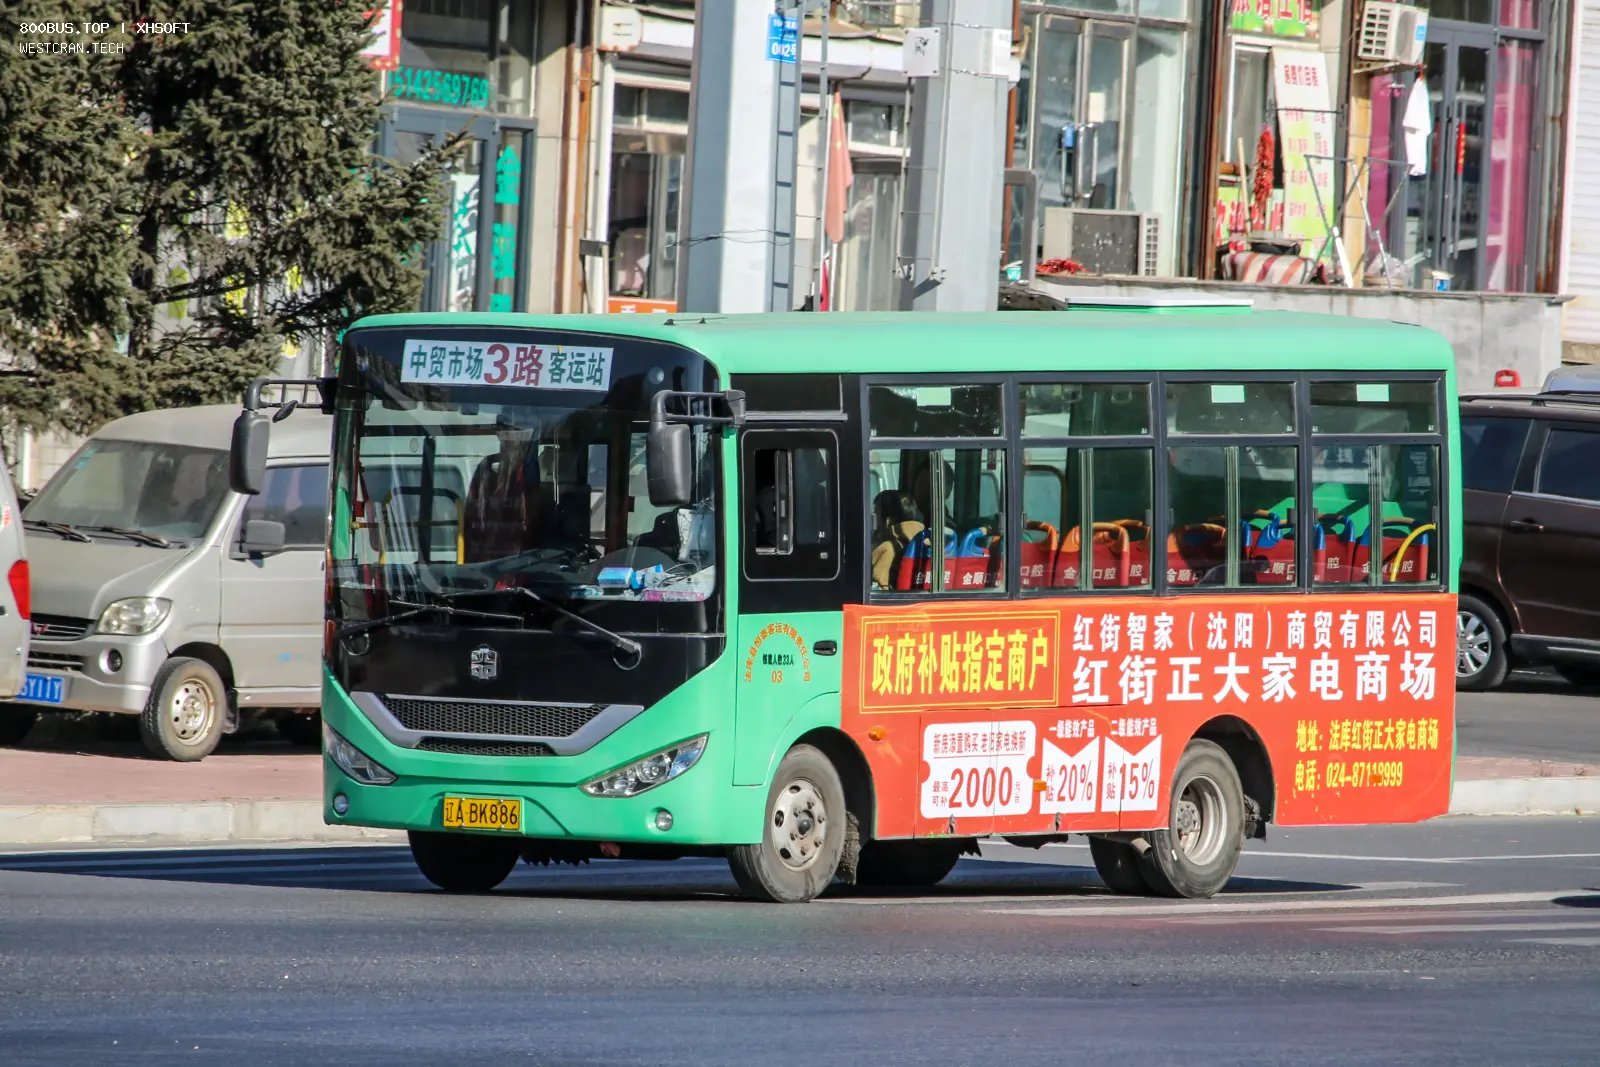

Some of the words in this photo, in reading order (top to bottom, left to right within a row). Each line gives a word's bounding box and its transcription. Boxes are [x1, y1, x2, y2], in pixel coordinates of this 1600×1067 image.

[410, 345, 484, 380] 中贸市场
[483, 343, 544, 387] 3路
[548, 350, 606, 386] 客运站
[1072, 609, 1437, 652] 红街智家（沈阳）商贸有限公司
[771, 670, 783, 683] 03
[872, 628, 1048, 696] 政府补贴指定商户
[1072, 651, 1436, 705] 红街正大家电商场
[1048, 719, 1095, 738] 一级能效产品
[1110, 718, 1157, 737] 二级能效产品
[948, 766, 1013, 808] 2000
[1044, 764, 1055, 802] 补贴
[1056, 760, 1093, 802] 20%
[1106, 762, 1117, 800] 补贴
[1119, 758, 1155, 800] 15%
